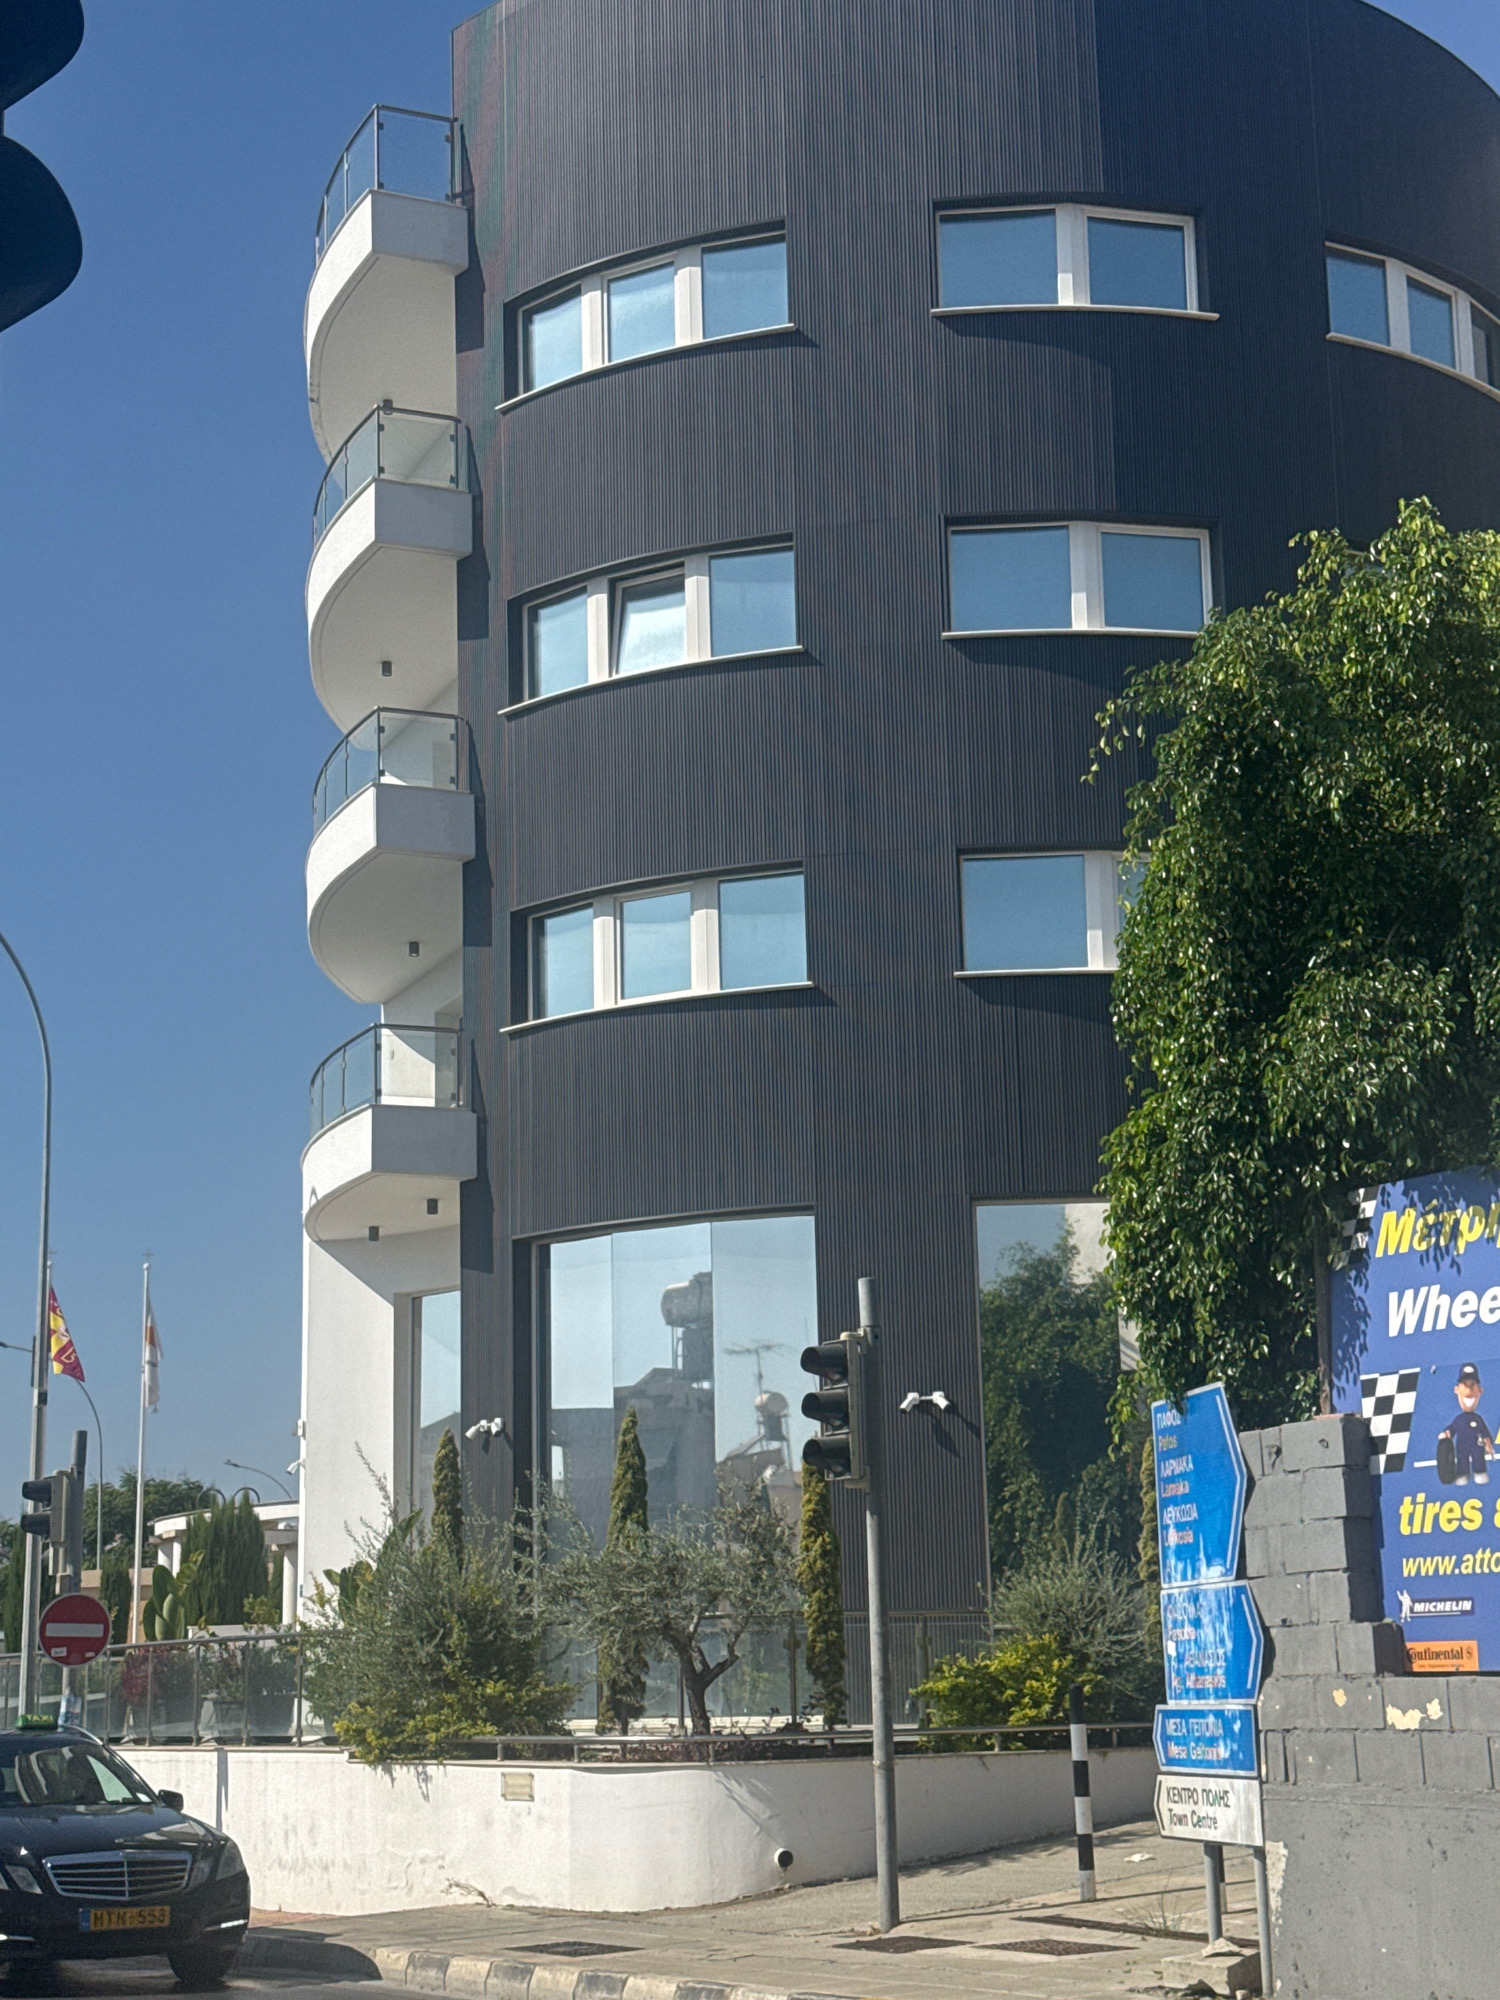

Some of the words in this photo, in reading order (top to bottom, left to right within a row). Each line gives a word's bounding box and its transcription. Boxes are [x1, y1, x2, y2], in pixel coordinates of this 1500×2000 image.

[1158, 1434, 1178, 1452] Pafos
[1161, 1454, 1194, 1478] ΛΑΡΝΑΚΑ
[1163, 1503, 1198, 1525] ΛΕΥΚΩΣΙΑ
[1399, 1493, 1483, 1536] tires
[1413, 1600, 1472, 1613] MICHELIN
[1408, 1646, 1463, 1663] Continental
[1165, 1718, 1188, 1736] ΜΕΣΑ
[1167, 1741, 1189, 1759] Mesa
[1166, 1786, 1199, 1806] ΚΕΝΤΡΟ
[1202, 1788, 1231, 1808] ΠΟΛΗΣ
[1168, 1808, 1189, 1826] Town
[1191, 1810, 1218, 1830] Centre
